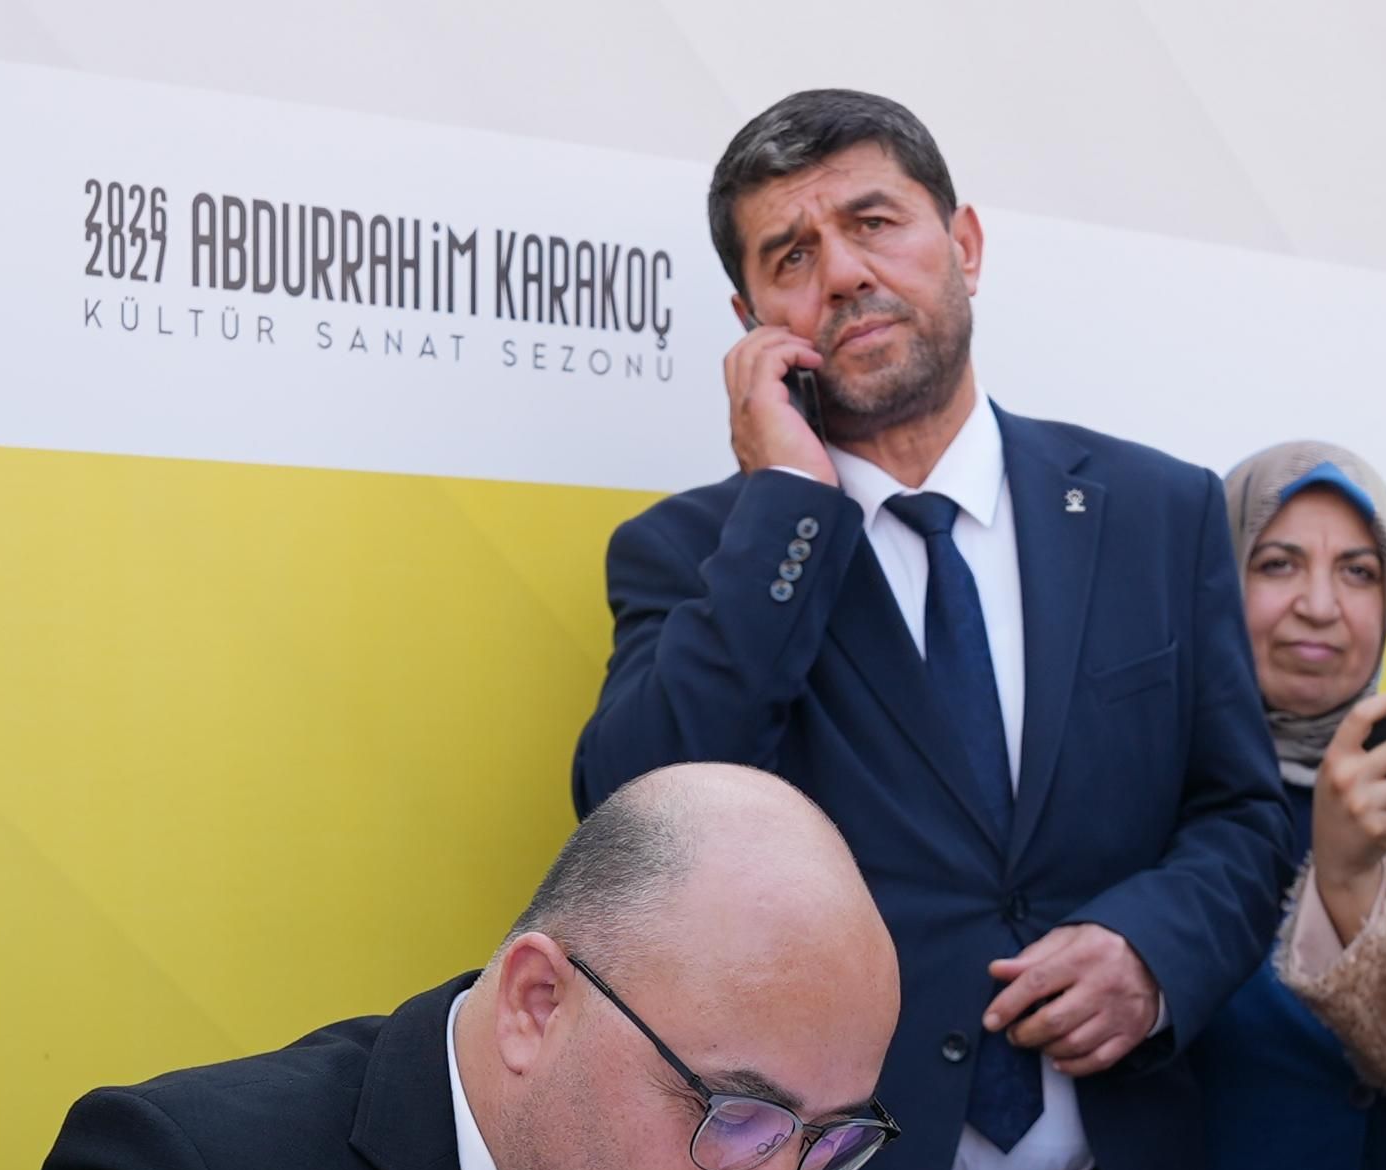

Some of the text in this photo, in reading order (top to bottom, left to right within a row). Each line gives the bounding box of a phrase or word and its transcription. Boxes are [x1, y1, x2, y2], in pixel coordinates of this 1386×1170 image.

[84, 178, 166, 238] 2026
[84, 220, 167, 283] 2027
[495, 228, 673, 350] KARAKOÇ
[83, 297, 674, 382] KÜLTÜR SANAT SEZONU
